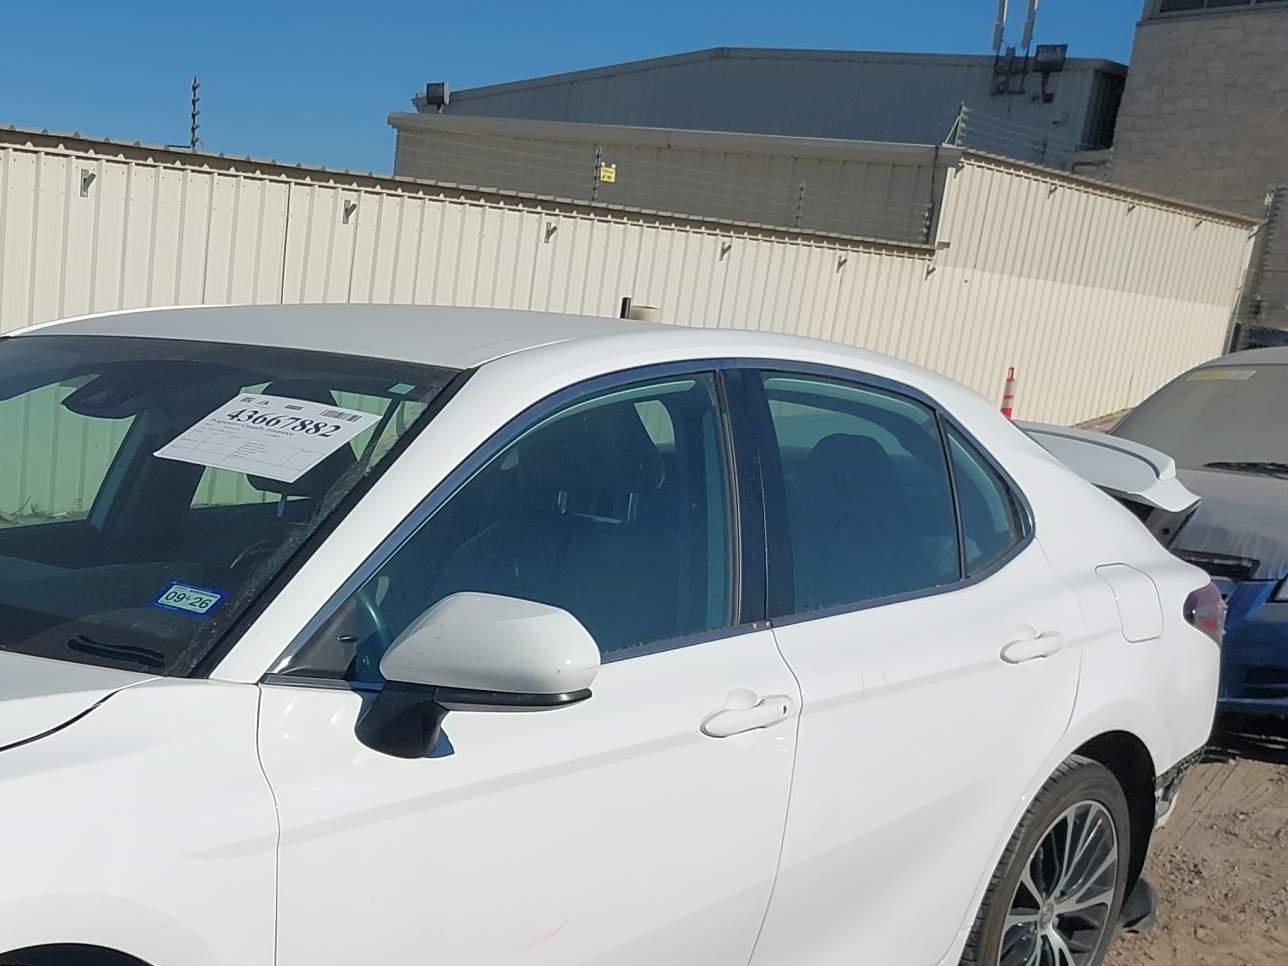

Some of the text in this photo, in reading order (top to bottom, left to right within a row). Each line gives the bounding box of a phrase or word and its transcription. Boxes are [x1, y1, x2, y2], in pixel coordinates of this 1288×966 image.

[226, 408, 341, 438] 43667882
[165, 591, 212, 609] 09 26
